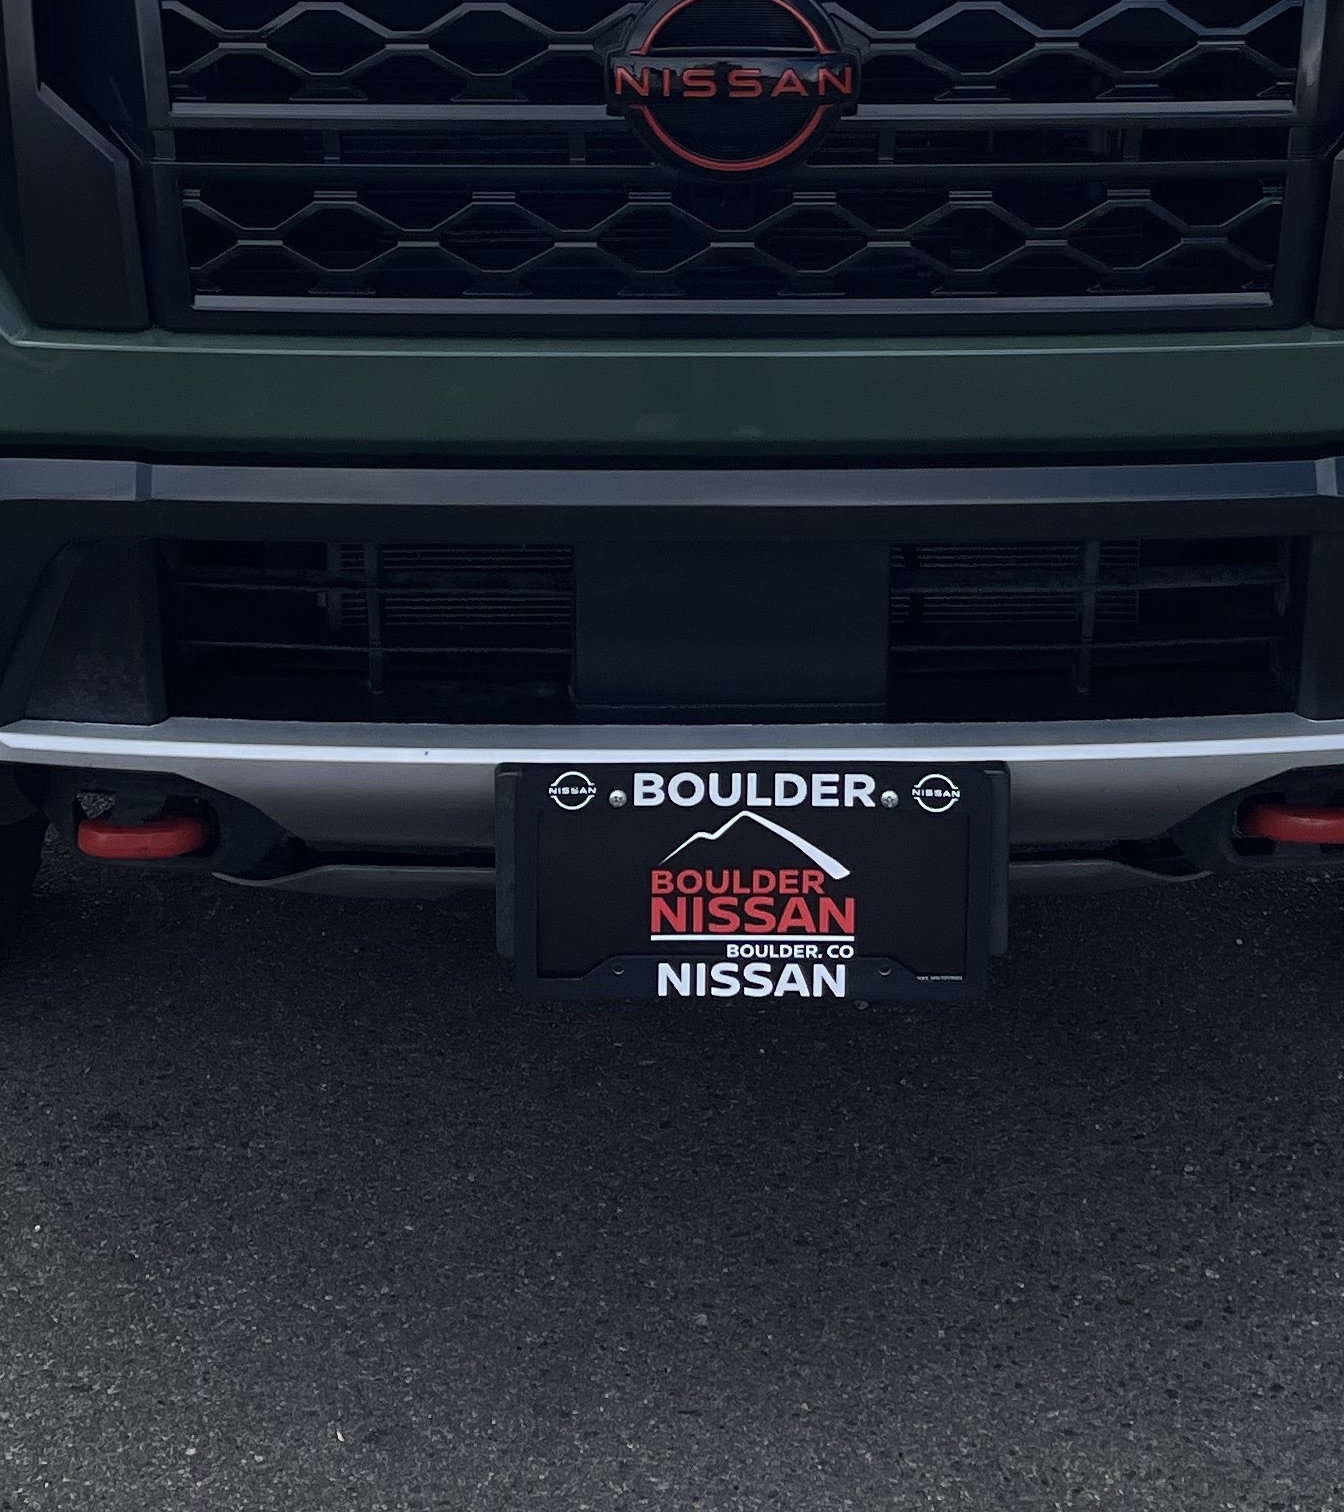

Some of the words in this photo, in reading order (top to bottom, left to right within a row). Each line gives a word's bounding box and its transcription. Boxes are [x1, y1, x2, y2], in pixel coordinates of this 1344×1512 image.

[613, 64, 853, 97] NISSAN
[548, 786, 597, 794] NISSAN
[633, 772, 876, 807] BOULDER
[911, 788, 960, 798] NISSAN
[651, 869, 825, 894] BOULDER
[650, 896, 855, 934] NISSAN
[826, 943, 855, 959] CO
[657, 961, 846, 998] NISSAN
